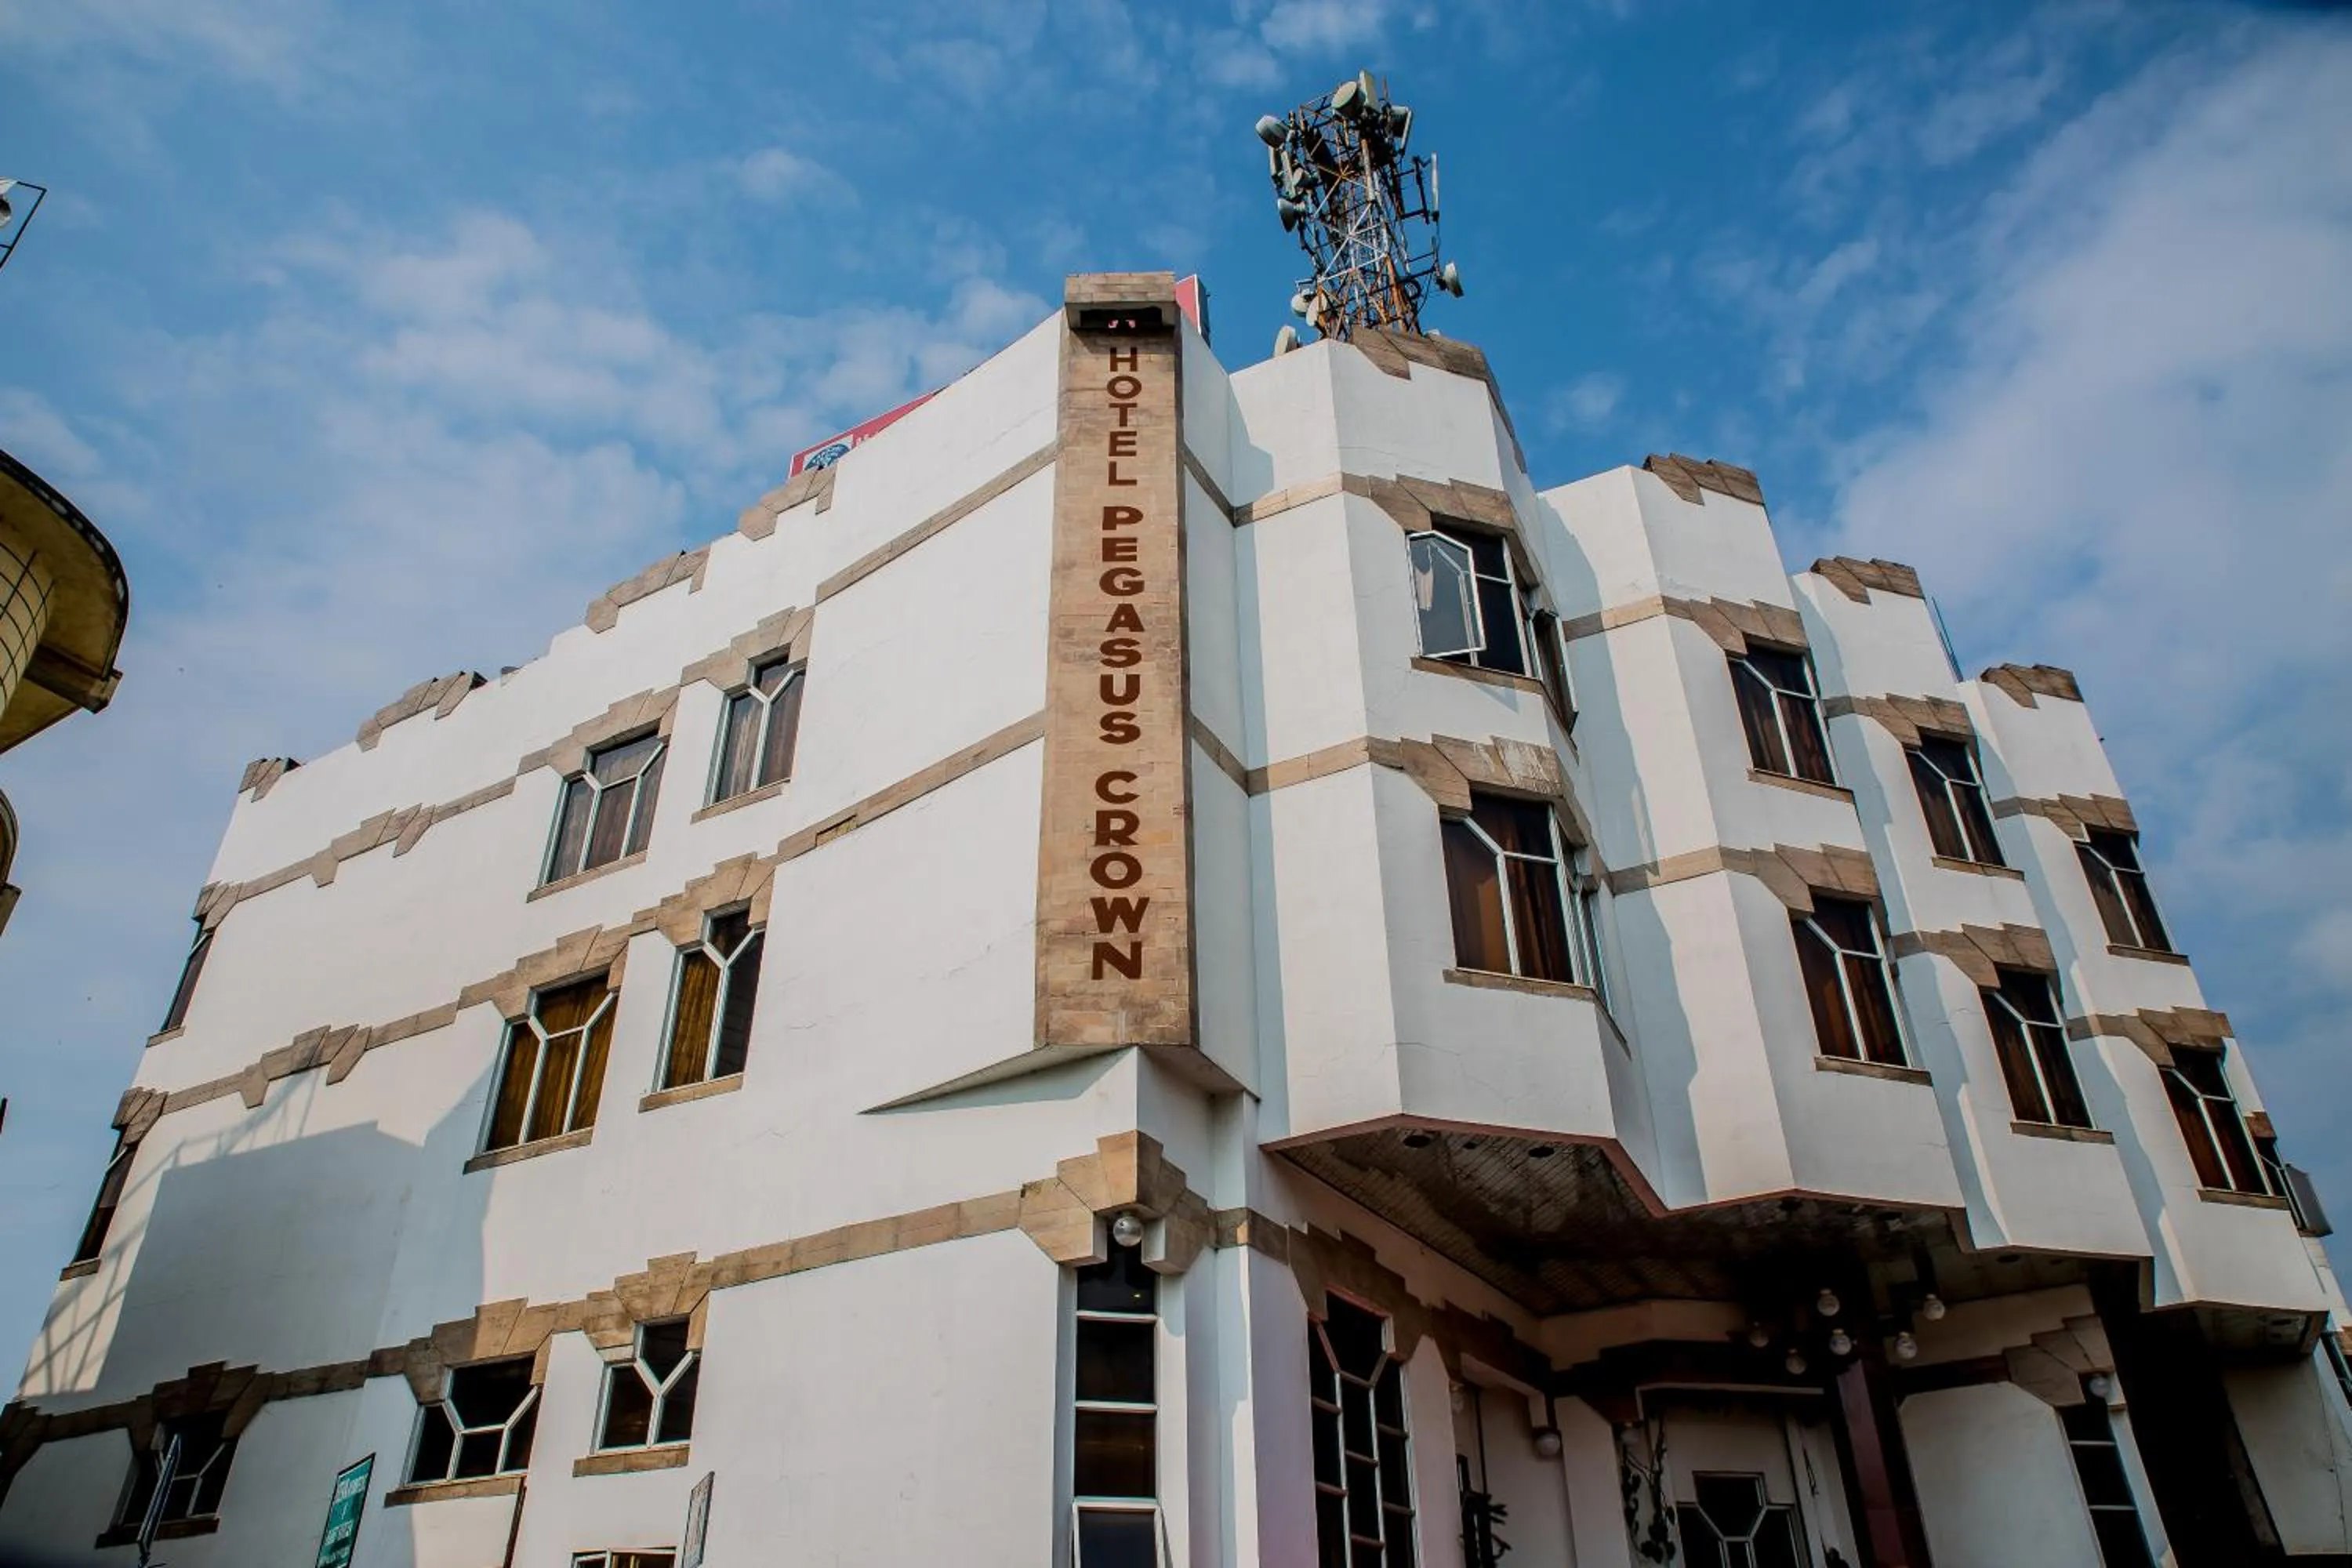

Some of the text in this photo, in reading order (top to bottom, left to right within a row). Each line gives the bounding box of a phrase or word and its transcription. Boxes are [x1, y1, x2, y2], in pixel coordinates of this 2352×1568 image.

[1091, 347, 1149, 980] HOTEL PEGASUS CROWN
